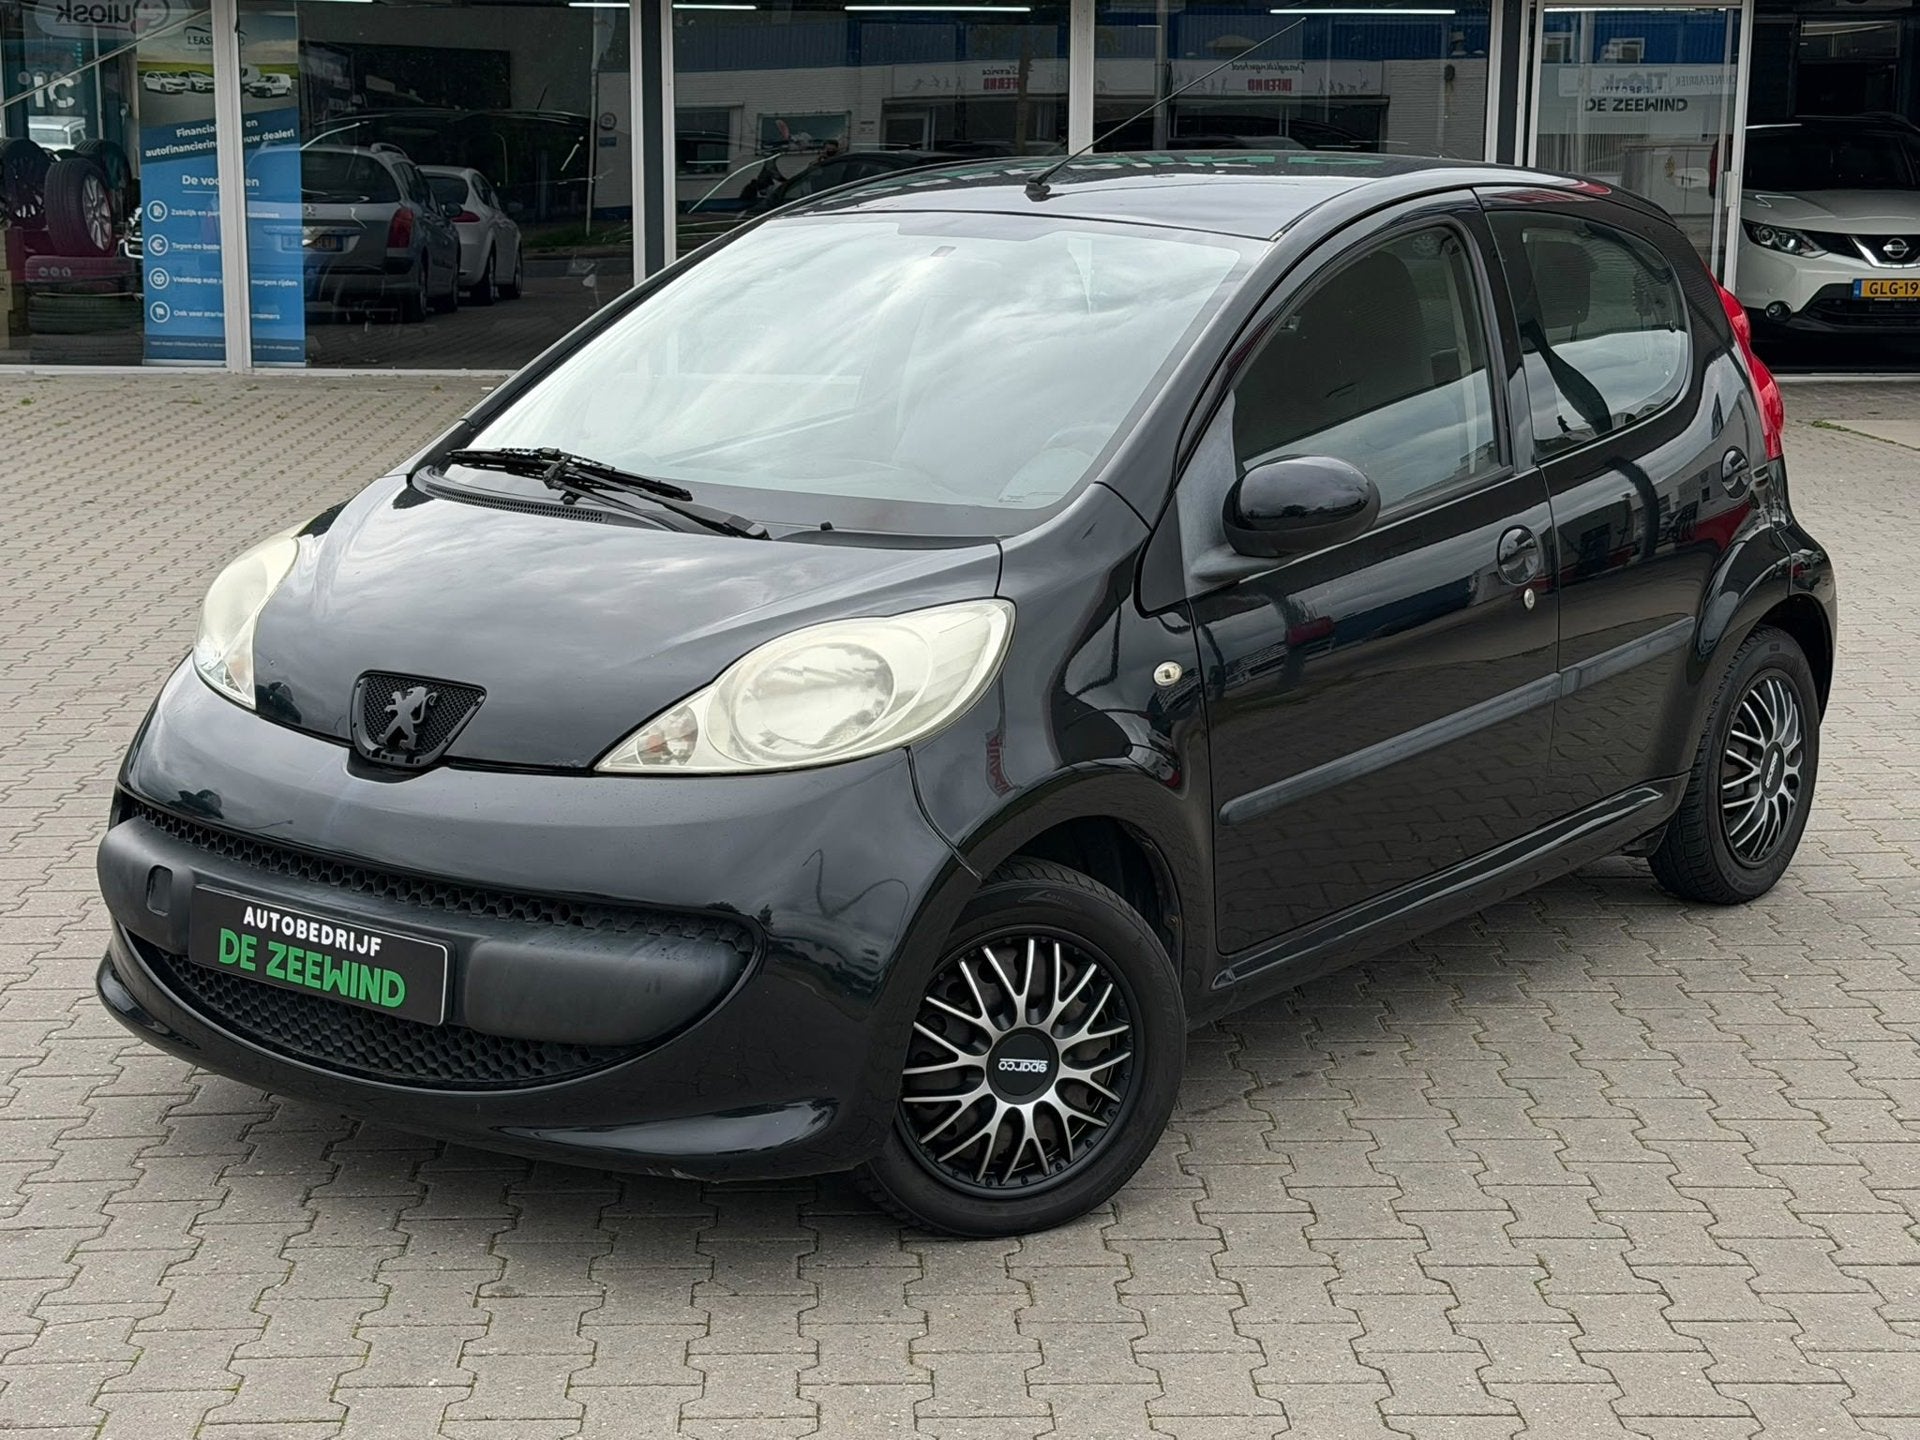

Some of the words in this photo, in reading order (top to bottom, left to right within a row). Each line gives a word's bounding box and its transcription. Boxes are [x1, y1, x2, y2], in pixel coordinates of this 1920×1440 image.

[1584, 98, 1607, 112] DE
[1612, 98, 1688, 112] ZEEWIND
[262, 128, 295, 140] dealer!
[182, 174, 199, 185] De
[1869, 282, 1919, 295] GLG-19
[243, 906, 382, 956] AUTOBEDRIJF
[218, 928, 257, 972] DE
[266, 942, 407, 1009] ZEEWIND
[998, 1058, 1048, 1073] sparco
